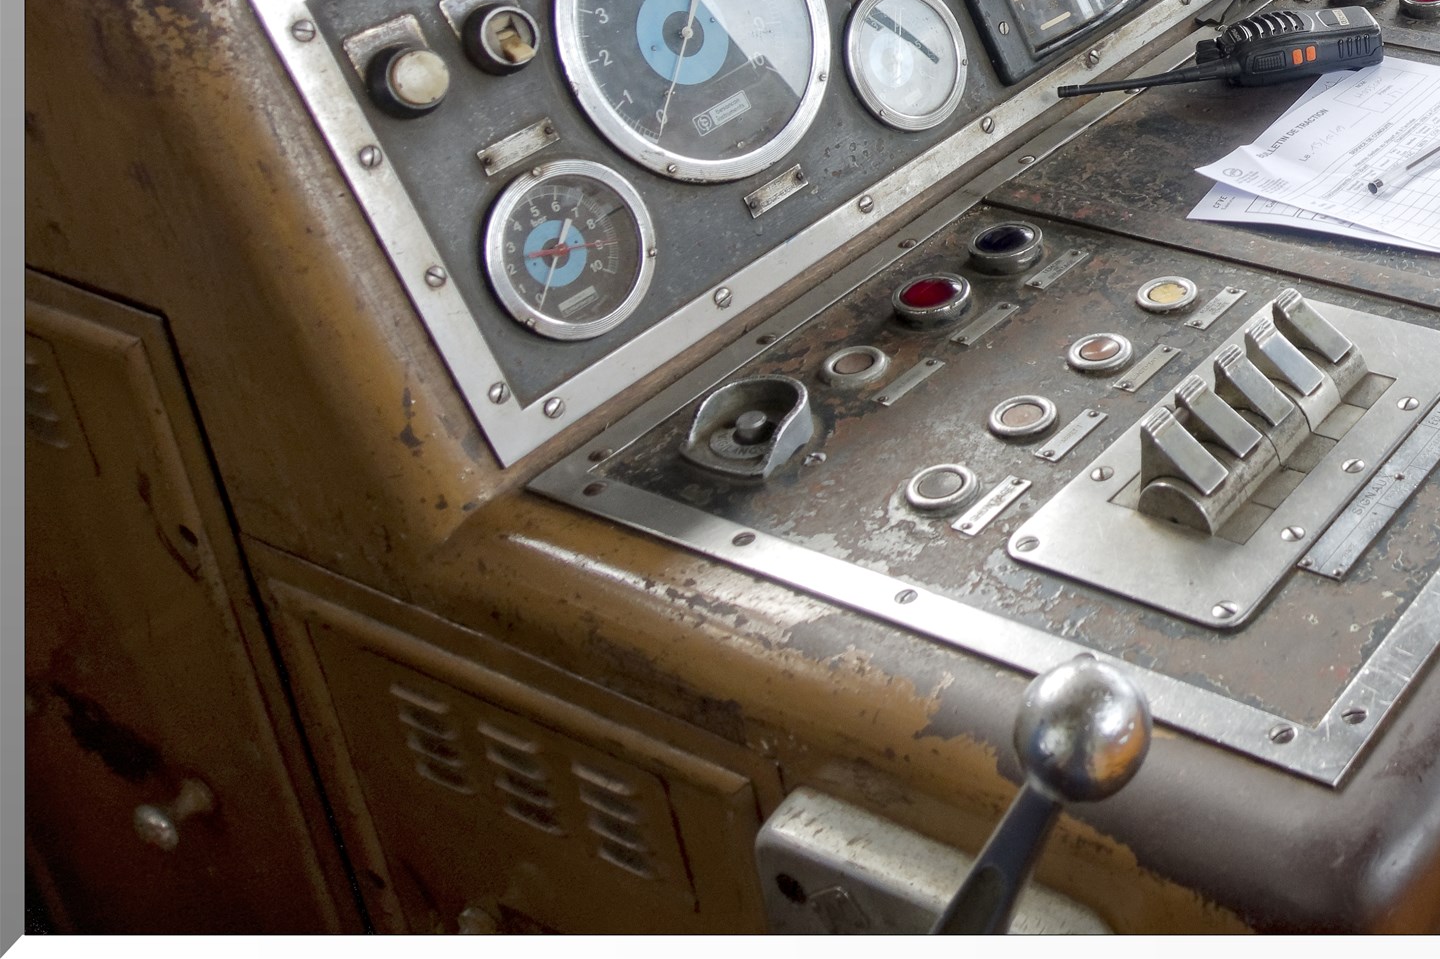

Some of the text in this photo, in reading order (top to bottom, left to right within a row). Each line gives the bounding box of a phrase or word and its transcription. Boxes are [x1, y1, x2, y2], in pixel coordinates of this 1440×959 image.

[595, 8, 609, 24] 3
[598, 49, 613, 66] 2
[622, 89, 633, 104] 1
[1256, 108, 1329, 159] BULLETIN DE TRACTION
[530, 206, 540, 217] 5
[551, 201, 561, 212] 6
[513, 221, 523, 232] 4
[530, 215, 548, 227] bar
[586, 218, 596, 230] 8
[506, 241, 516, 253] 3
[507, 263, 517, 276] 2
[590, 259, 603, 273] 10
[1352, 473, 1393, 516] SIGNAUX
